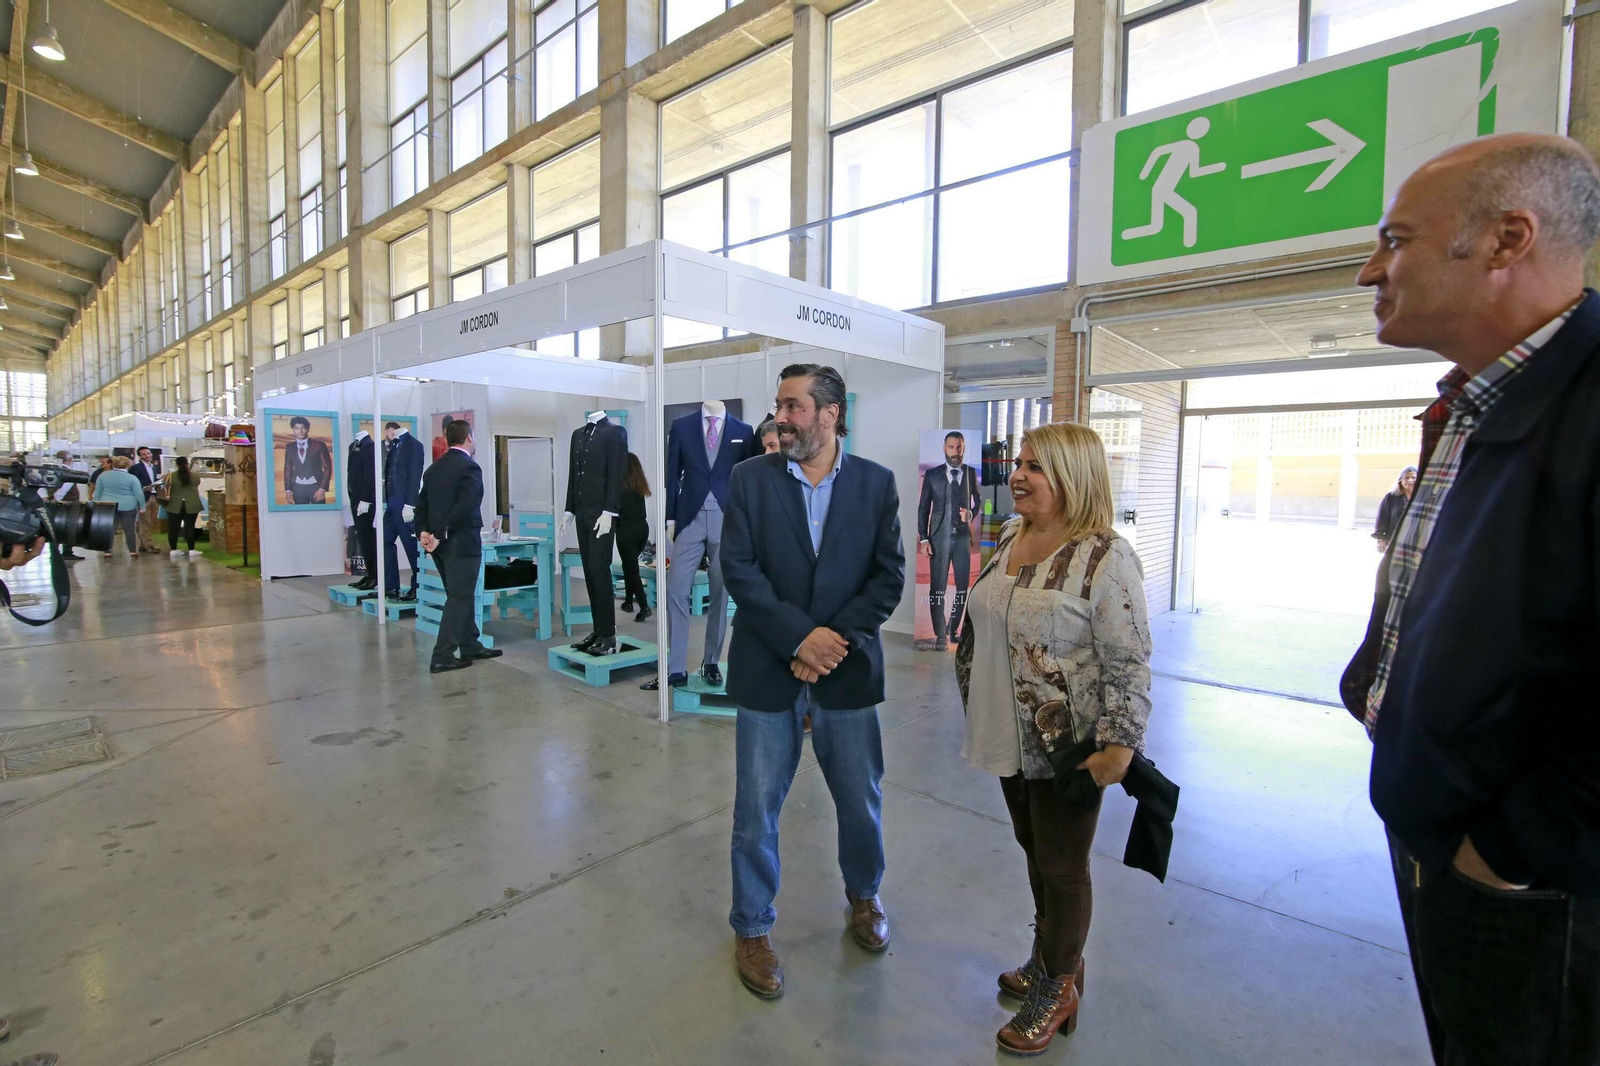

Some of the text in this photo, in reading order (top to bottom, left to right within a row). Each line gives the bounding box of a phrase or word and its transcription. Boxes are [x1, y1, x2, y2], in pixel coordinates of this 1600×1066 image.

[459, 310, 499, 335] JM CORDON
[797, 304, 850, 331] JM CORDON
